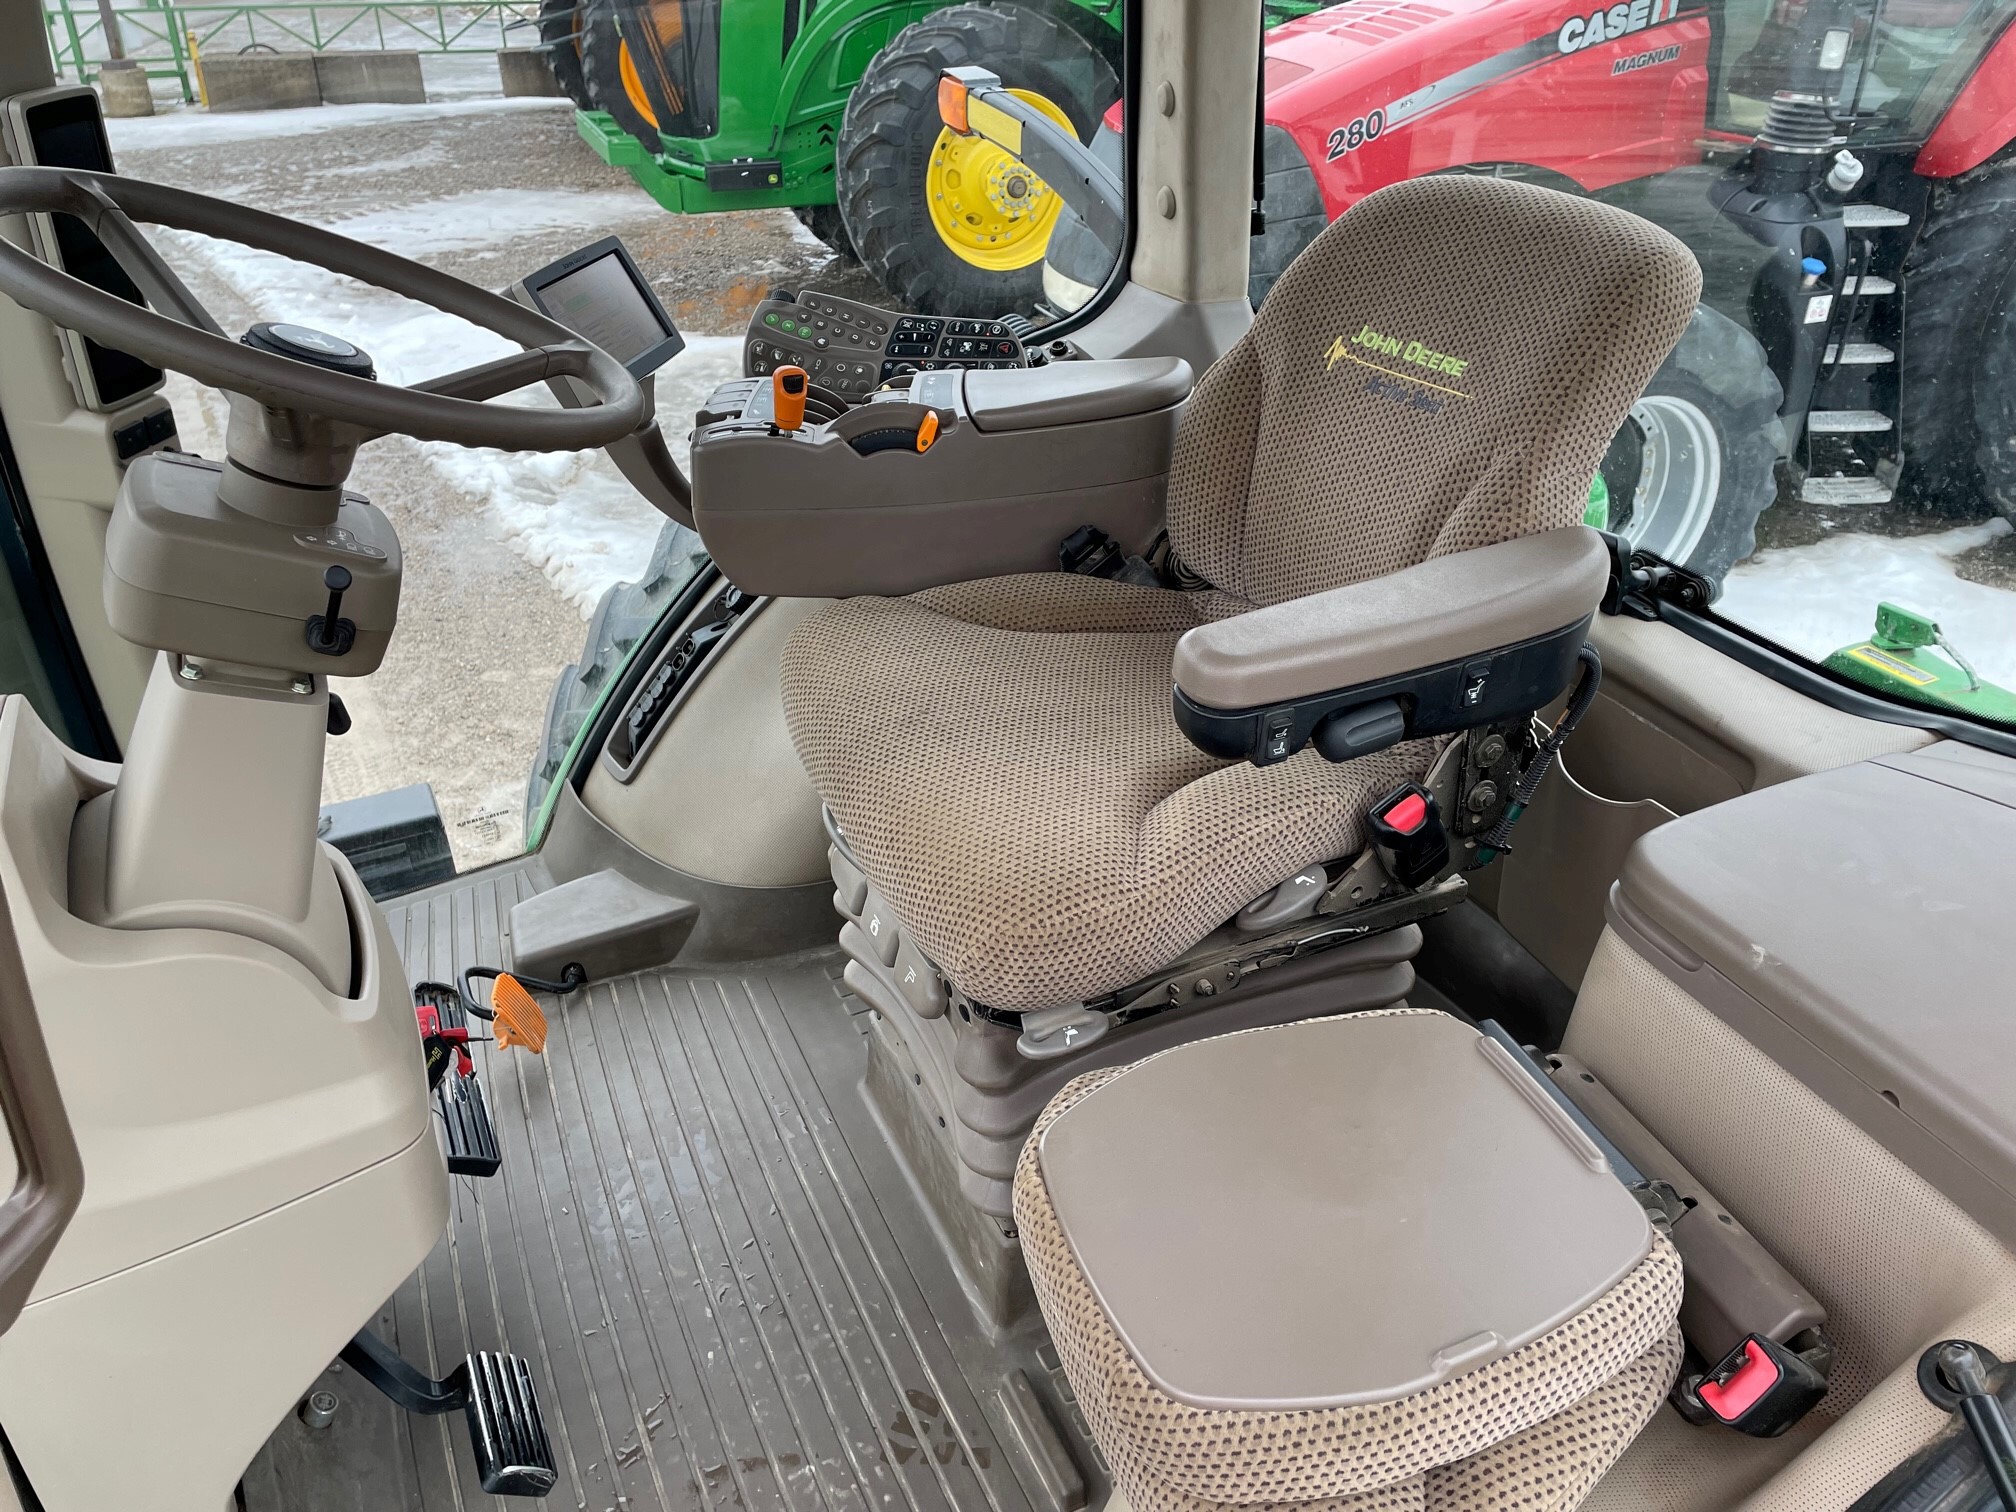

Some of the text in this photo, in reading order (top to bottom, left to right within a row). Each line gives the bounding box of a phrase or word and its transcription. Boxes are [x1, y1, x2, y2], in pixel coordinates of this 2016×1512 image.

[1558, 0, 1651, 53] CASE
[1611, 45, 1681, 75] MAGNUM
[1326, 108, 1385, 163] 280
[1351, 324, 1469, 377] JOHN DEERE
